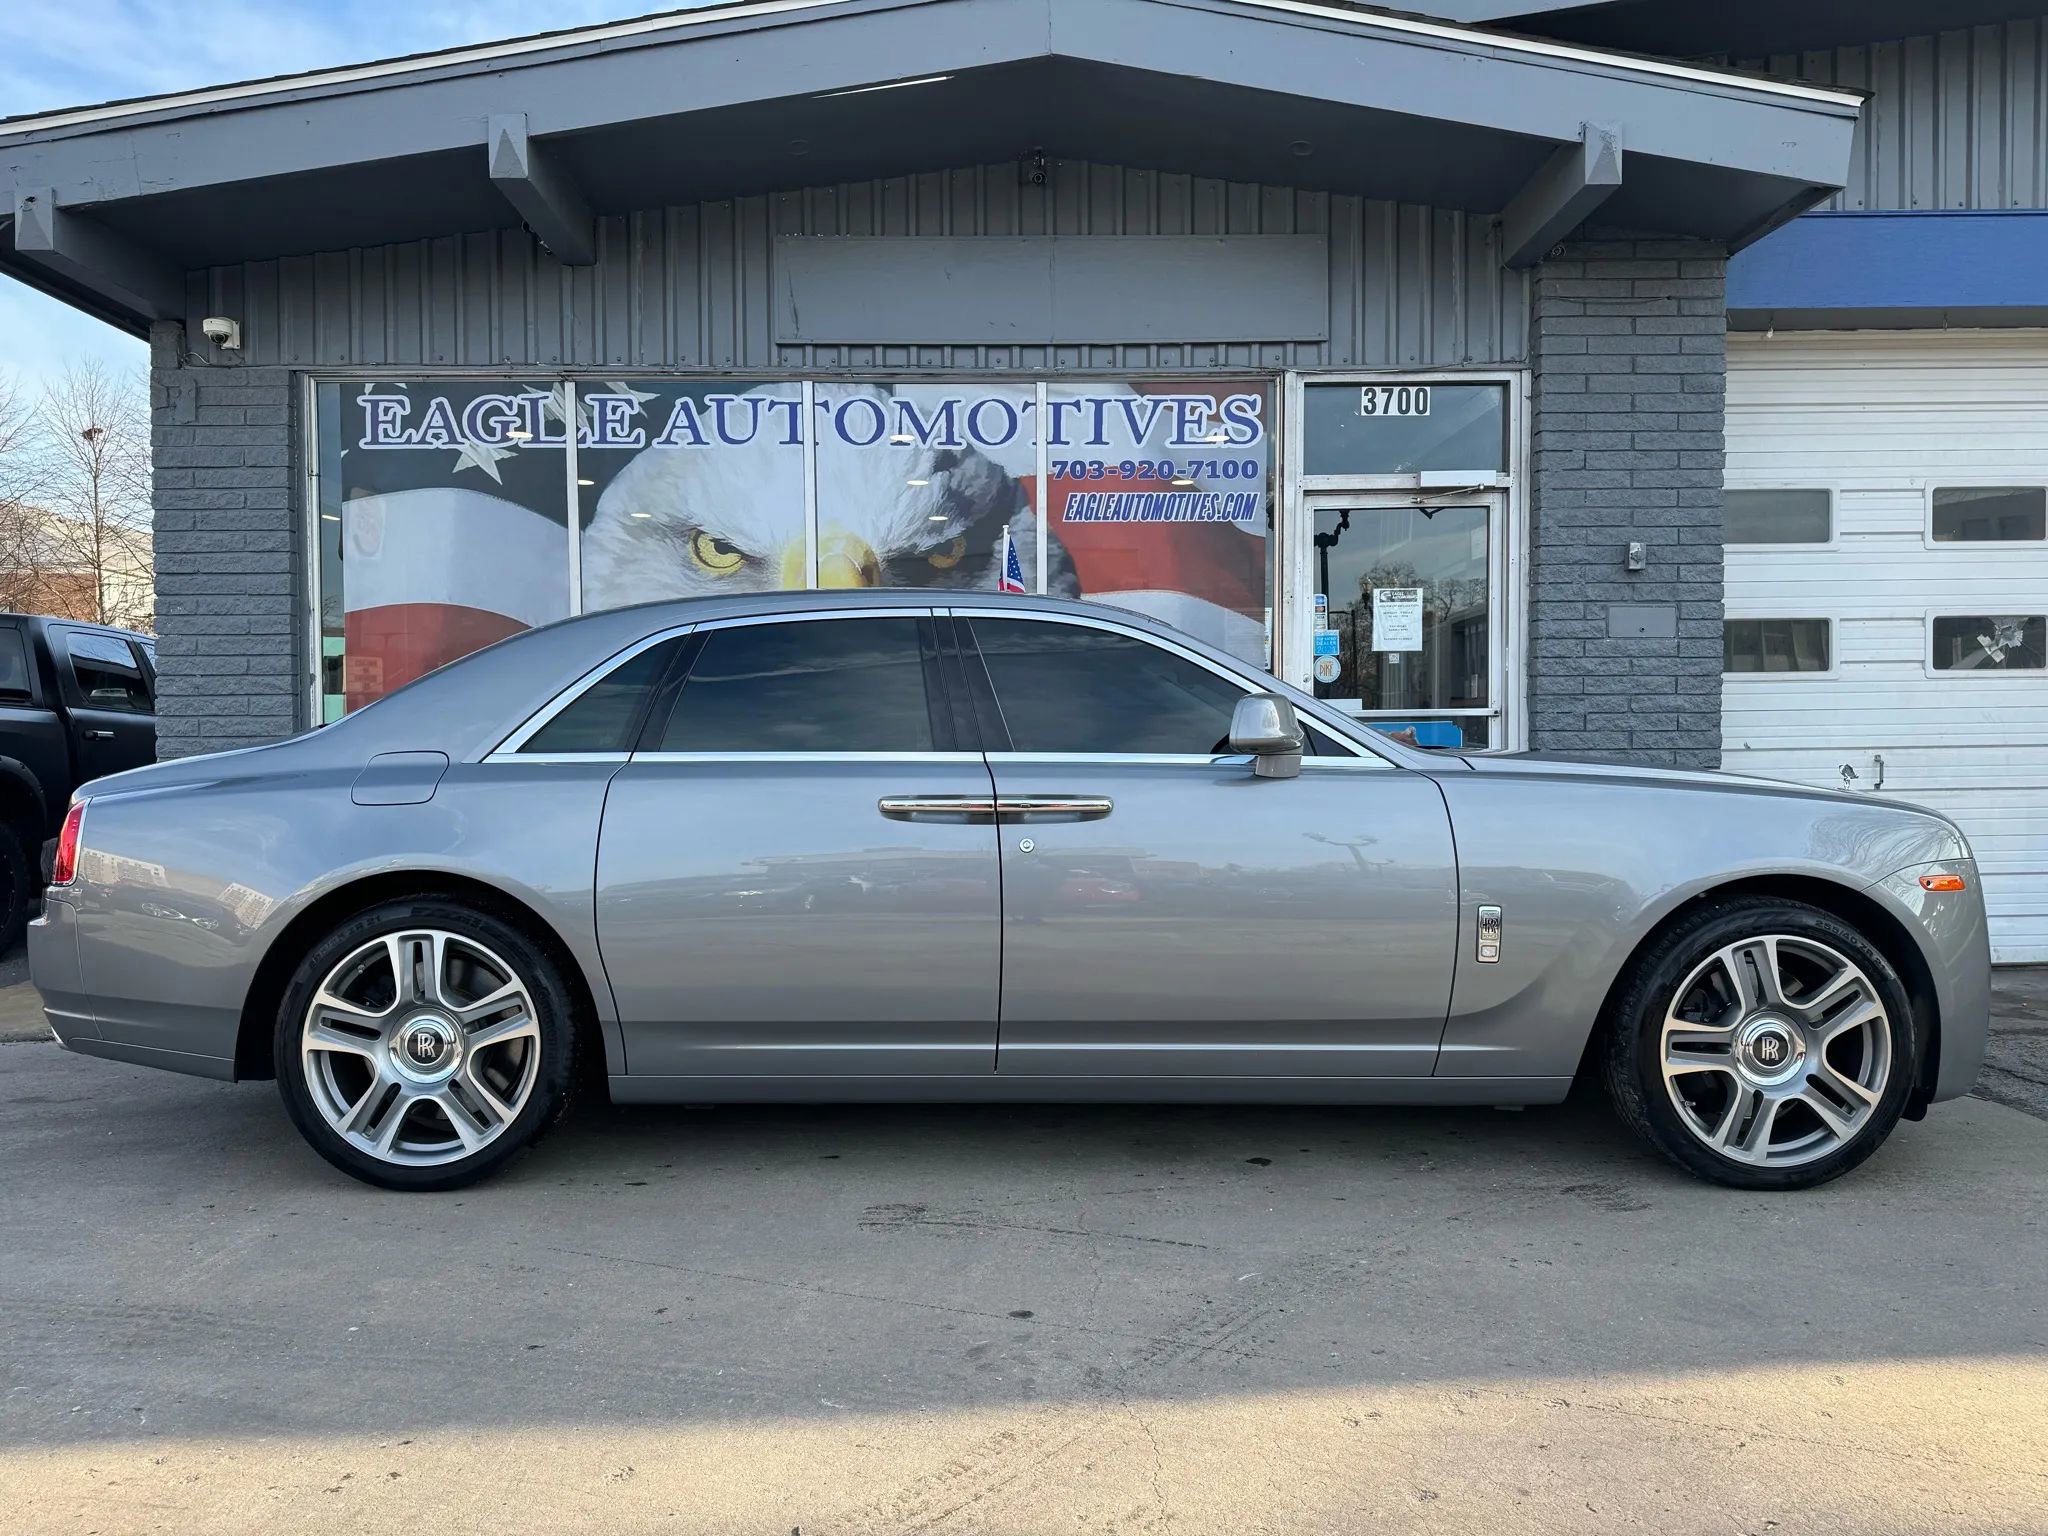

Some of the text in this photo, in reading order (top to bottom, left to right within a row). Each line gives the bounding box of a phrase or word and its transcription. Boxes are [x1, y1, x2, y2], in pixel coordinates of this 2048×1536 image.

[1363, 387, 1429, 415] 3700
[357, 394, 1265, 450] EAGLE AUTOMOTIVES
[1052, 460, 1259, 480] 703-920-7100
[1063, 492, 1260, 522] EAGLEAUTOMOTIVES.COM
[1319, 662, 1334, 677] PIKE
[417, 1033, 436, 1057] RR
[1761, 1036, 1780, 1060] RR
